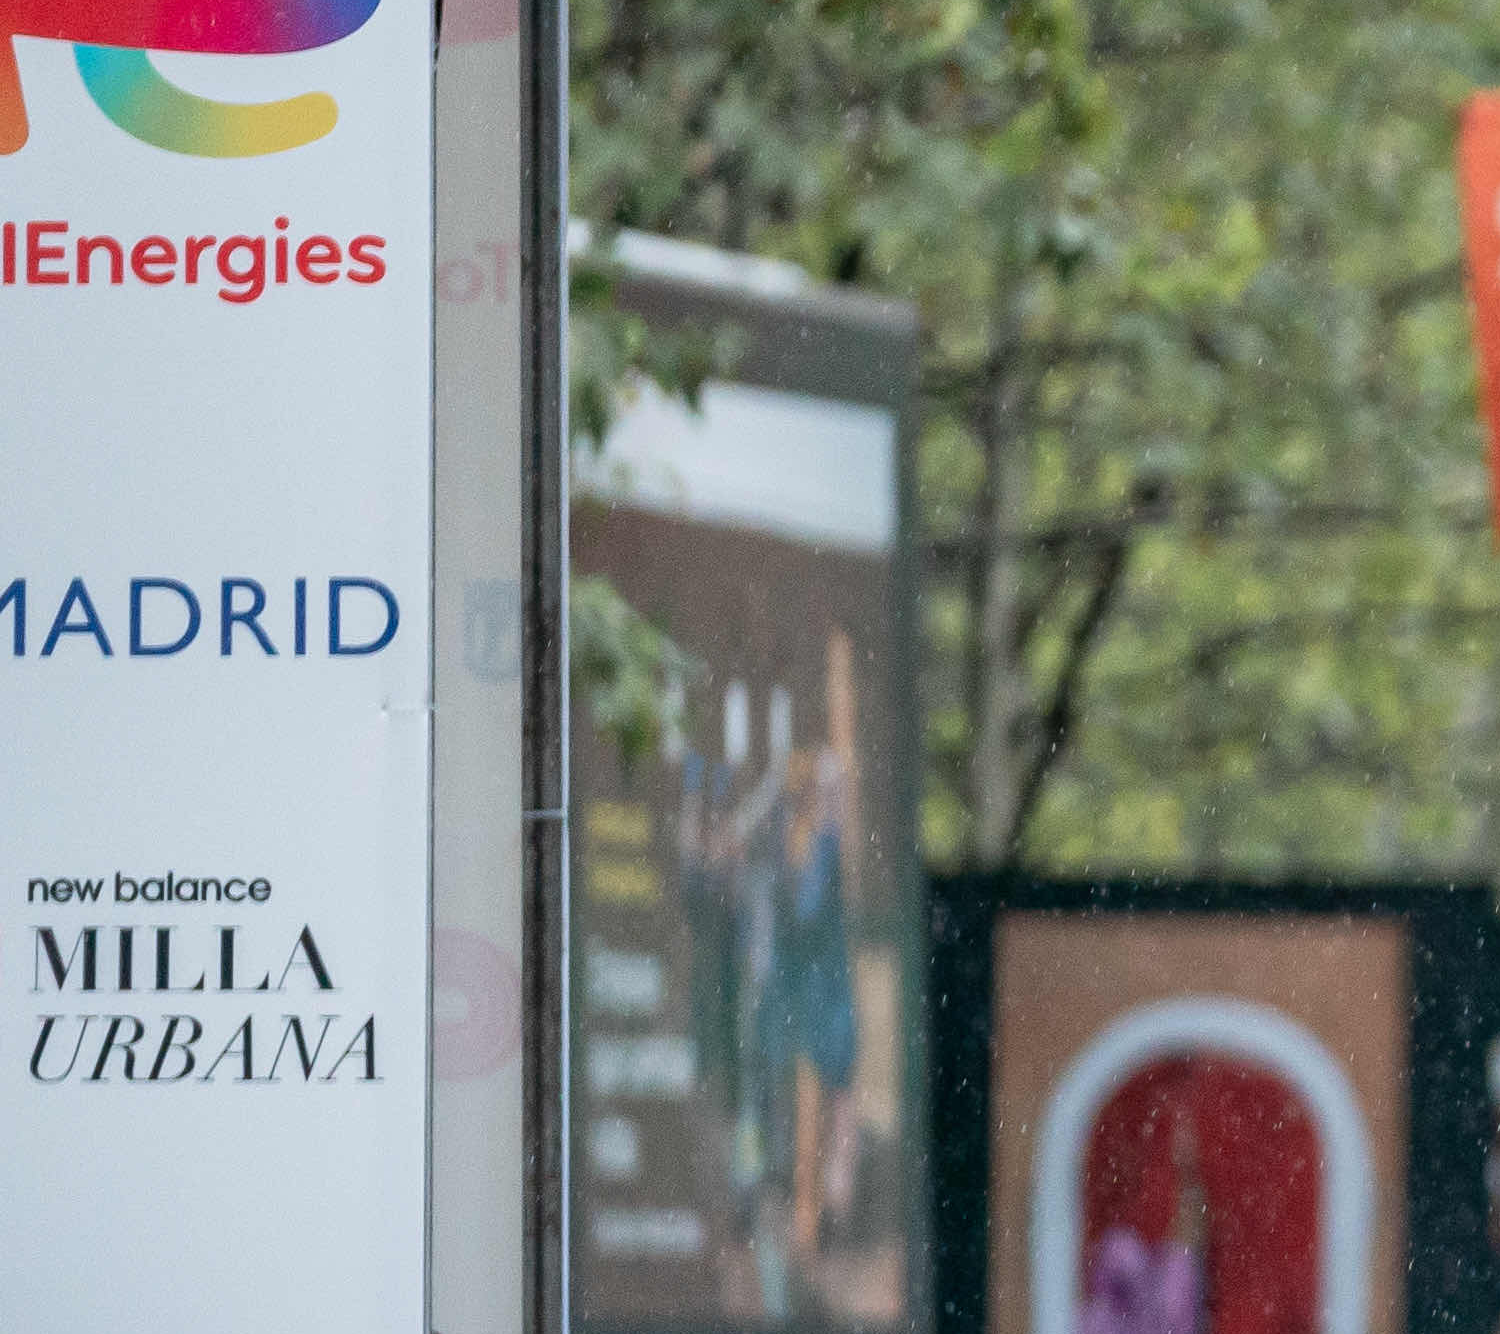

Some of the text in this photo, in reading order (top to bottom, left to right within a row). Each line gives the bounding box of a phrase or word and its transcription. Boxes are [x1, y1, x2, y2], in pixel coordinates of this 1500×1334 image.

[28, 872, 271, 903] new balance
[30, 923, 342, 993] MILLA
[28, 1013, 384, 1083] URBANA
